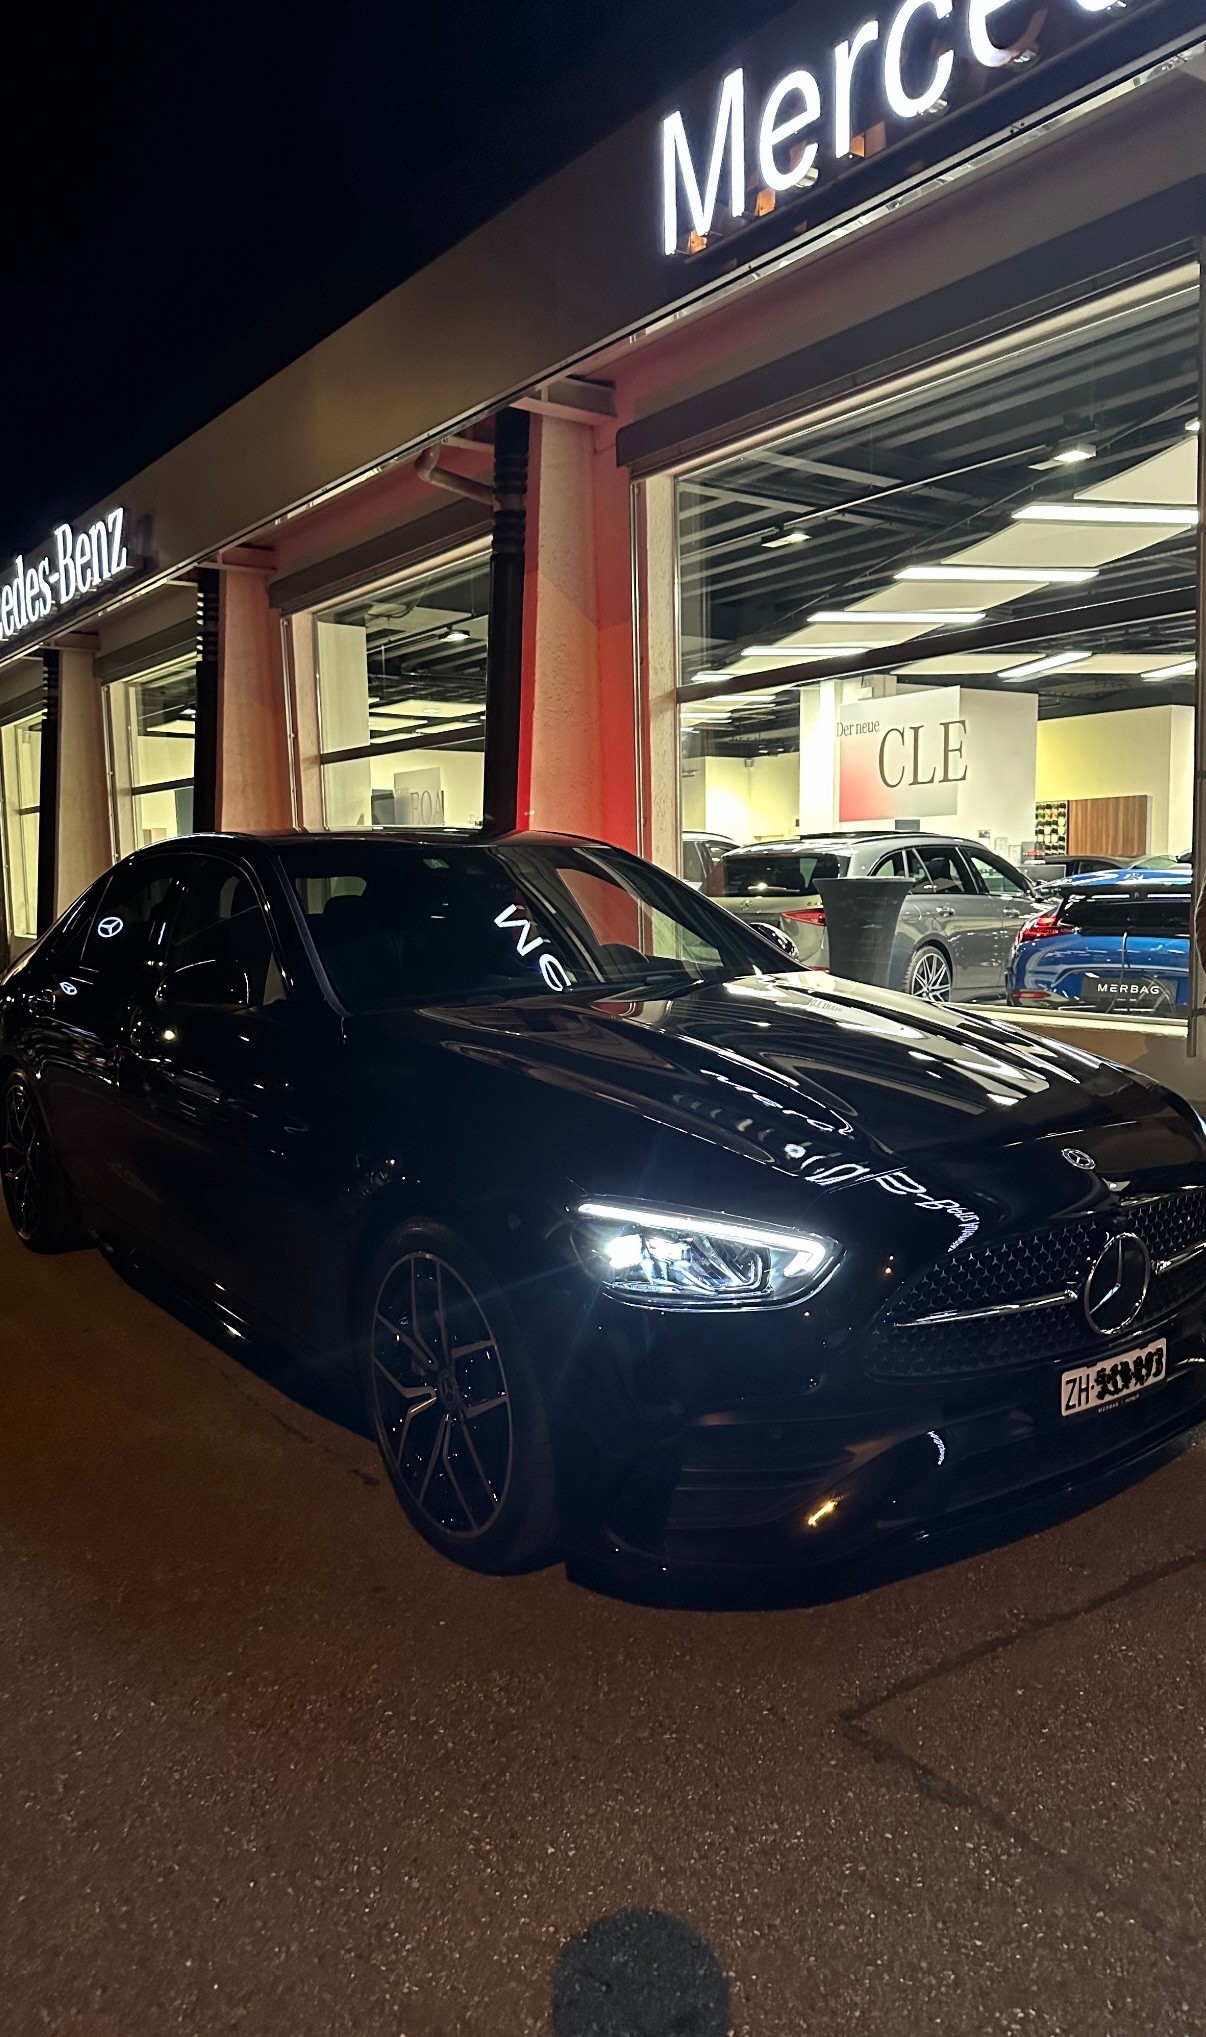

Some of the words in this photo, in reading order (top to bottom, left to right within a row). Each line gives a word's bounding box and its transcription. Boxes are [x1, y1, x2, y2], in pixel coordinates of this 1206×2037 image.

[0, 507, 127, 638] edes-Benz
[836, 721, 854, 737] Der
[855, 720, 880, 735] neue
[878, 720, 968, 788] CLE
[1097, 983, 1160, 995] MERBAG
